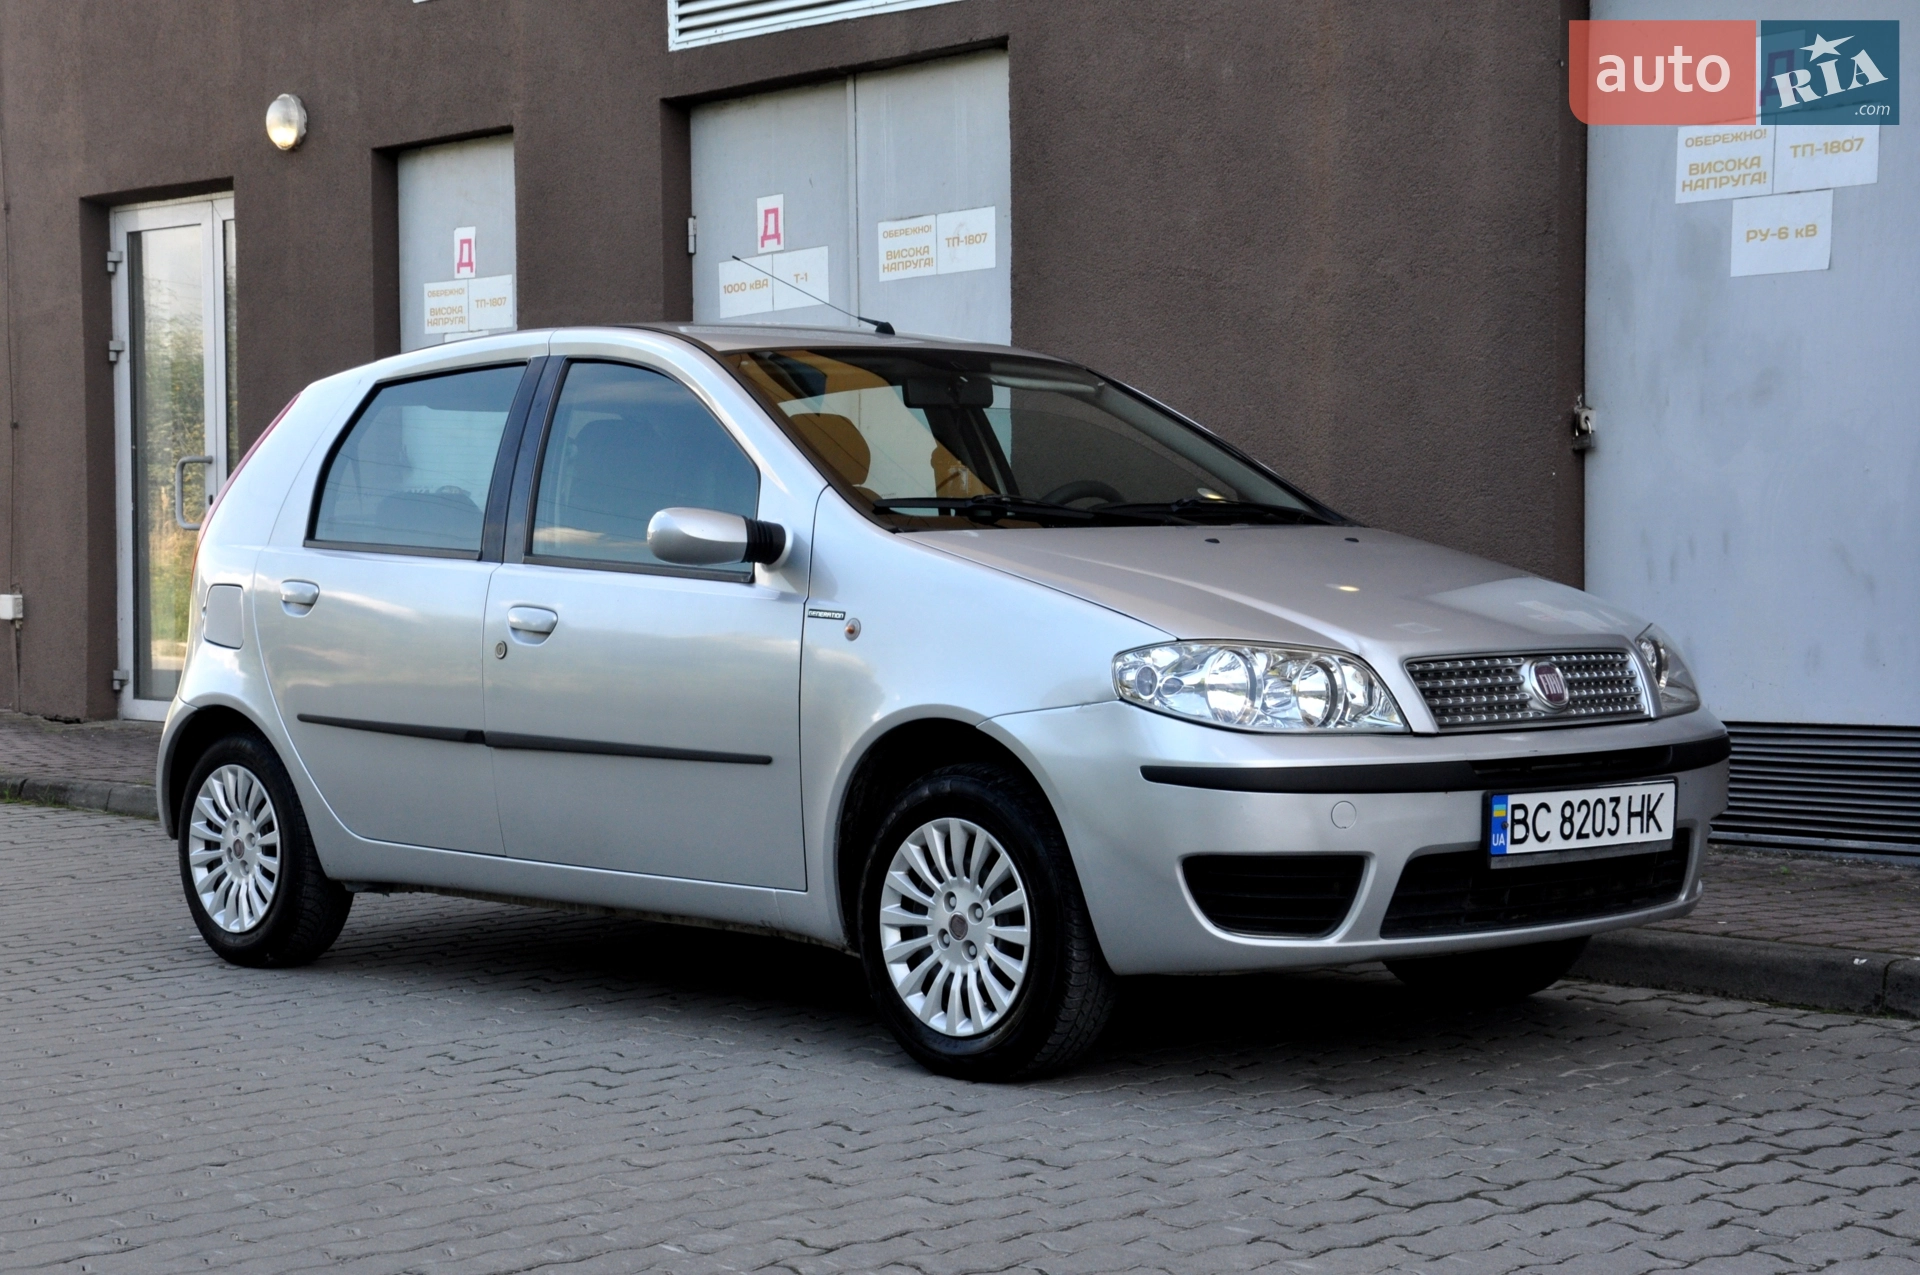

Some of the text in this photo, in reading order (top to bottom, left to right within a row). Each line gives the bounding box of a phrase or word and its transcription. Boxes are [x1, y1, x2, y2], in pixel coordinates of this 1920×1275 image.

[1684, 129, 1768, 149] ОБЕРЕЖНО!
[1789, 138, 1865, 159] ТП-1807
[1688, 156, 1762, 177] ВИСОКА
[1681, 172, 1768, 193] НАПРУГА!
[760, 207, 781, 248] Д
[882, 225, 932, 239] ОБЕРЕЖНО!
[1746, 224, 1818, 243] РУ-6 кВ
[945, 233, 988, 248] ТП-1807
[457, 238, 473, 273] Д
[886, 246, 930, 261] ВИСОКА
[882, 259, 934, 274] НАПРУГА!
[723, 278, 769, 294] 1000 кВА
[794, 274, 808, 284] Т-1
[428, 288, 465, 297] ОБЕРЕЖНО!
[475, 297, 507, 308] ТП-1807
[430, 306, 463, 316] ВИСОКА
[427, 316, 465, 327] НАПРУГА!
[1510, 793, 1664, 845] BC 8203 HK
[1492, 833, 1505, 846] UA
